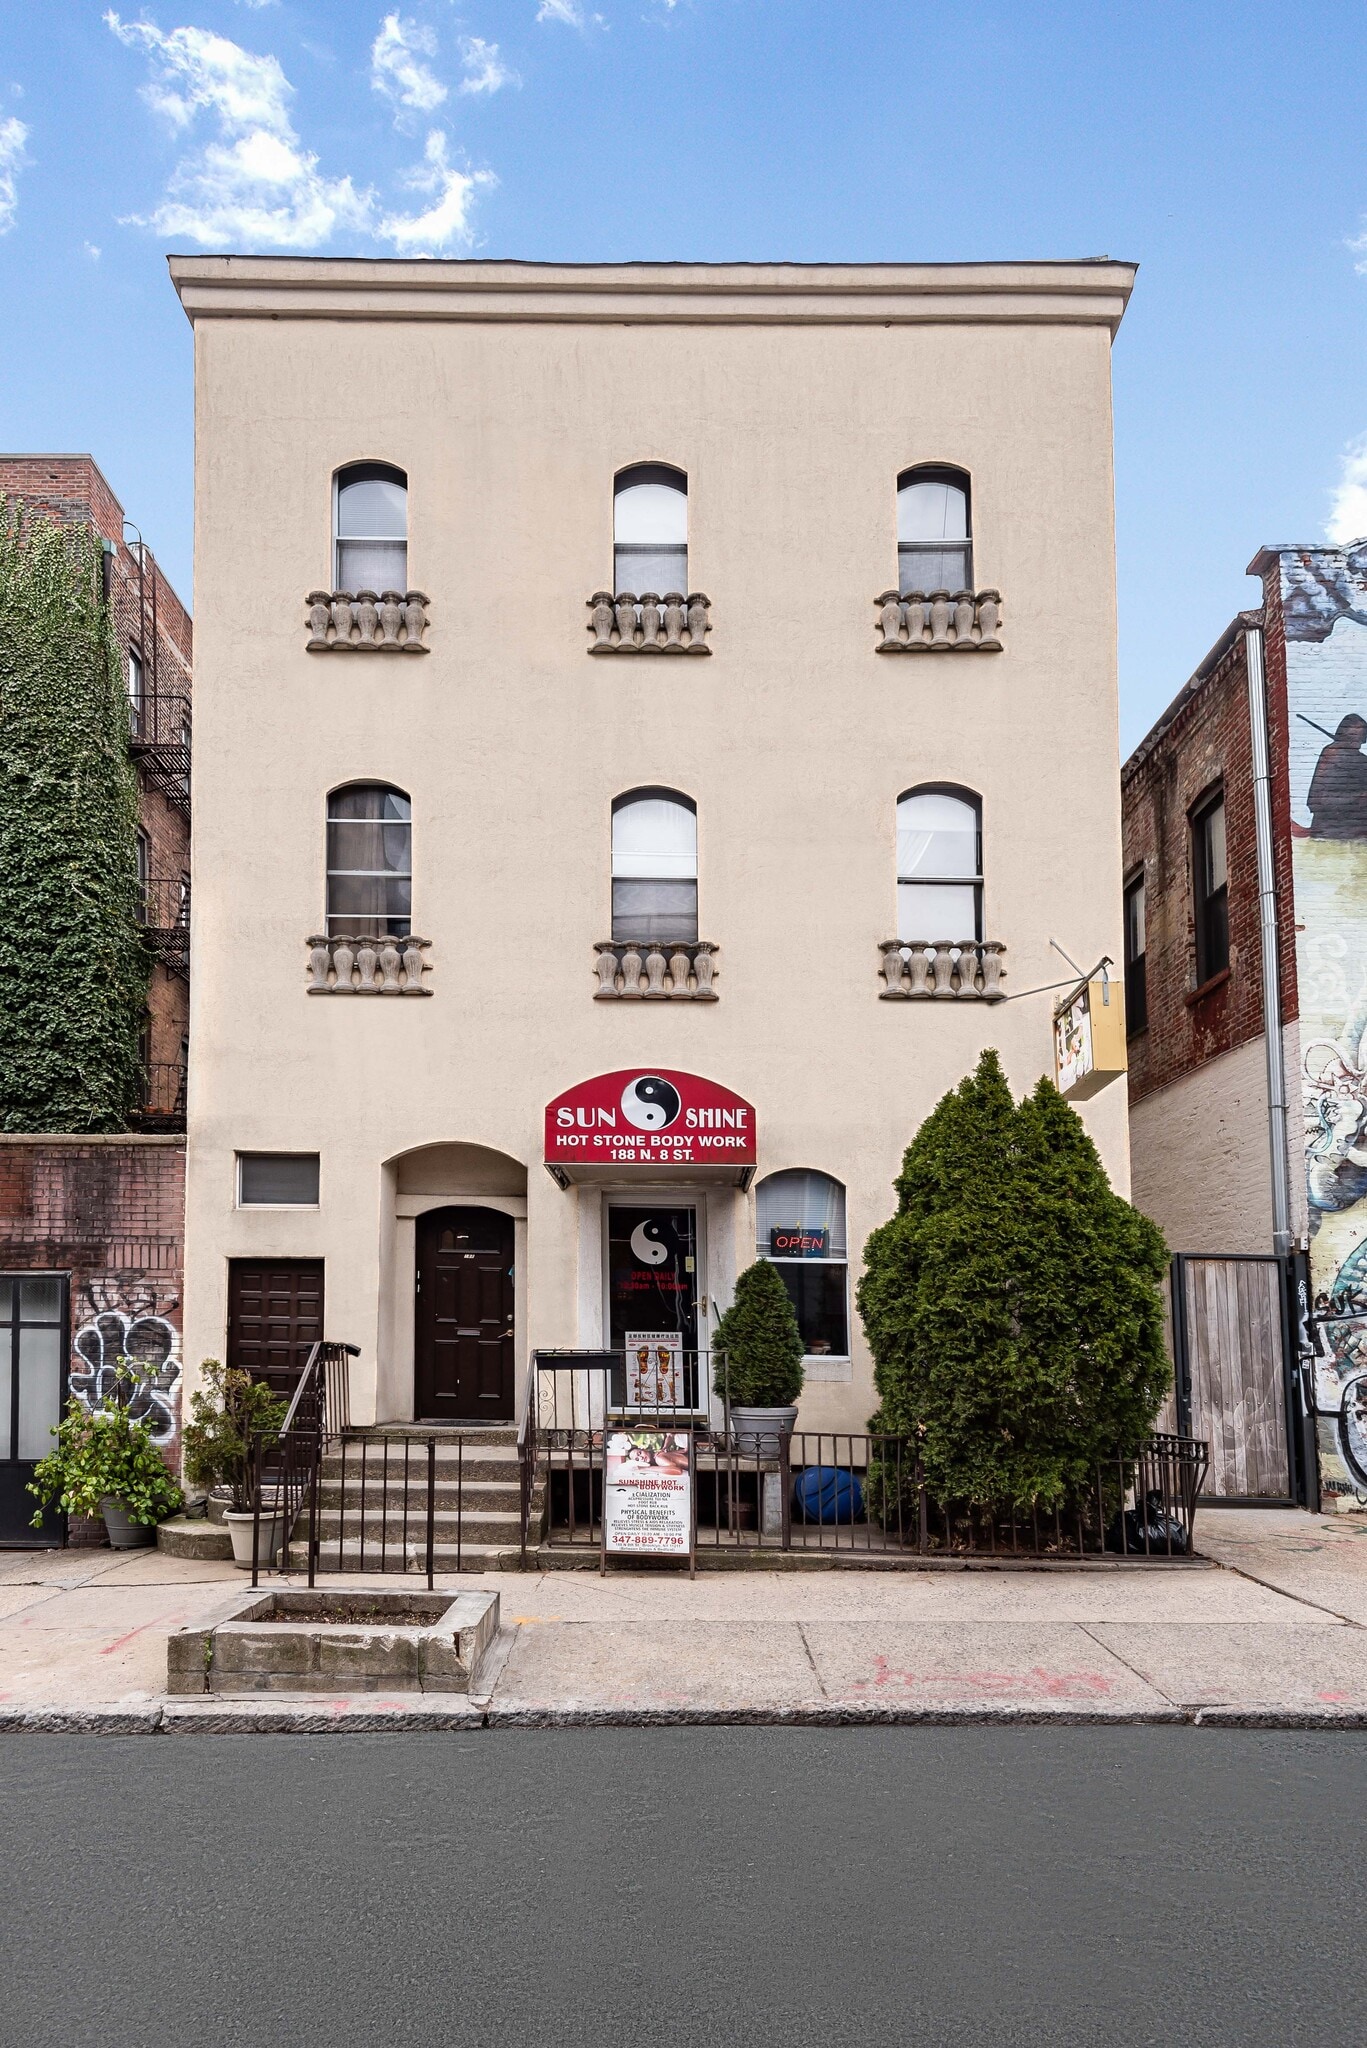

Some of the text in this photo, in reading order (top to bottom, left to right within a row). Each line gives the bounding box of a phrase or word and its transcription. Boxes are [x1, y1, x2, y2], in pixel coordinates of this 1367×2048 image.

[556, 1107, 748, 1129] SUN SHINE
[556, 1135, 747, 1147] HOT STONE BODY WORK
[610, 1149, 695, 1160] 188 N. 8 ST.
[776, 1236, 824, 1249] OPEN
[631, 1271, 676, 1280] OPEN DAILY
[612, 1535, 684, 1545] 347-889-7796
